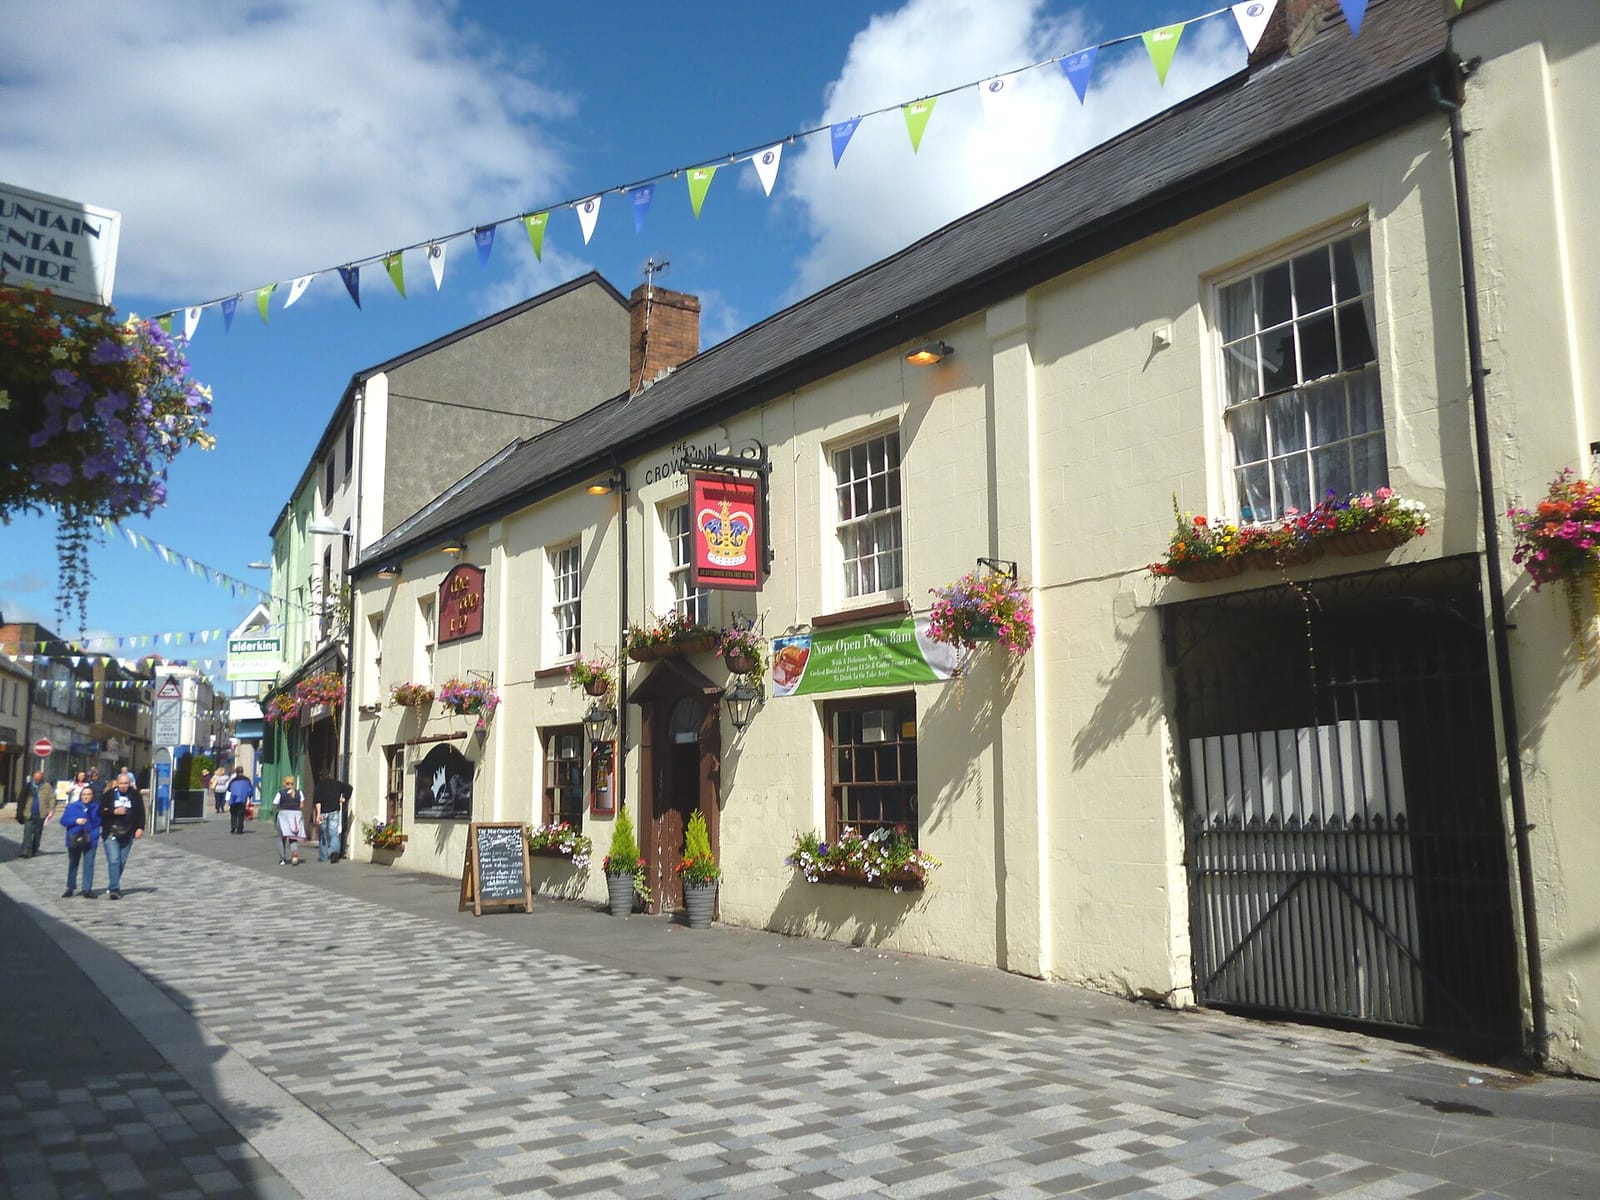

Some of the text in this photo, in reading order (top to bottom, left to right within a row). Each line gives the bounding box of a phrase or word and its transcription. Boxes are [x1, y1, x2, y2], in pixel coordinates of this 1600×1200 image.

[672, 441, 687, 456] THE
[645, 455, 690, 485] CROW
[814, 631, 911, 655] Now Open From 8am
